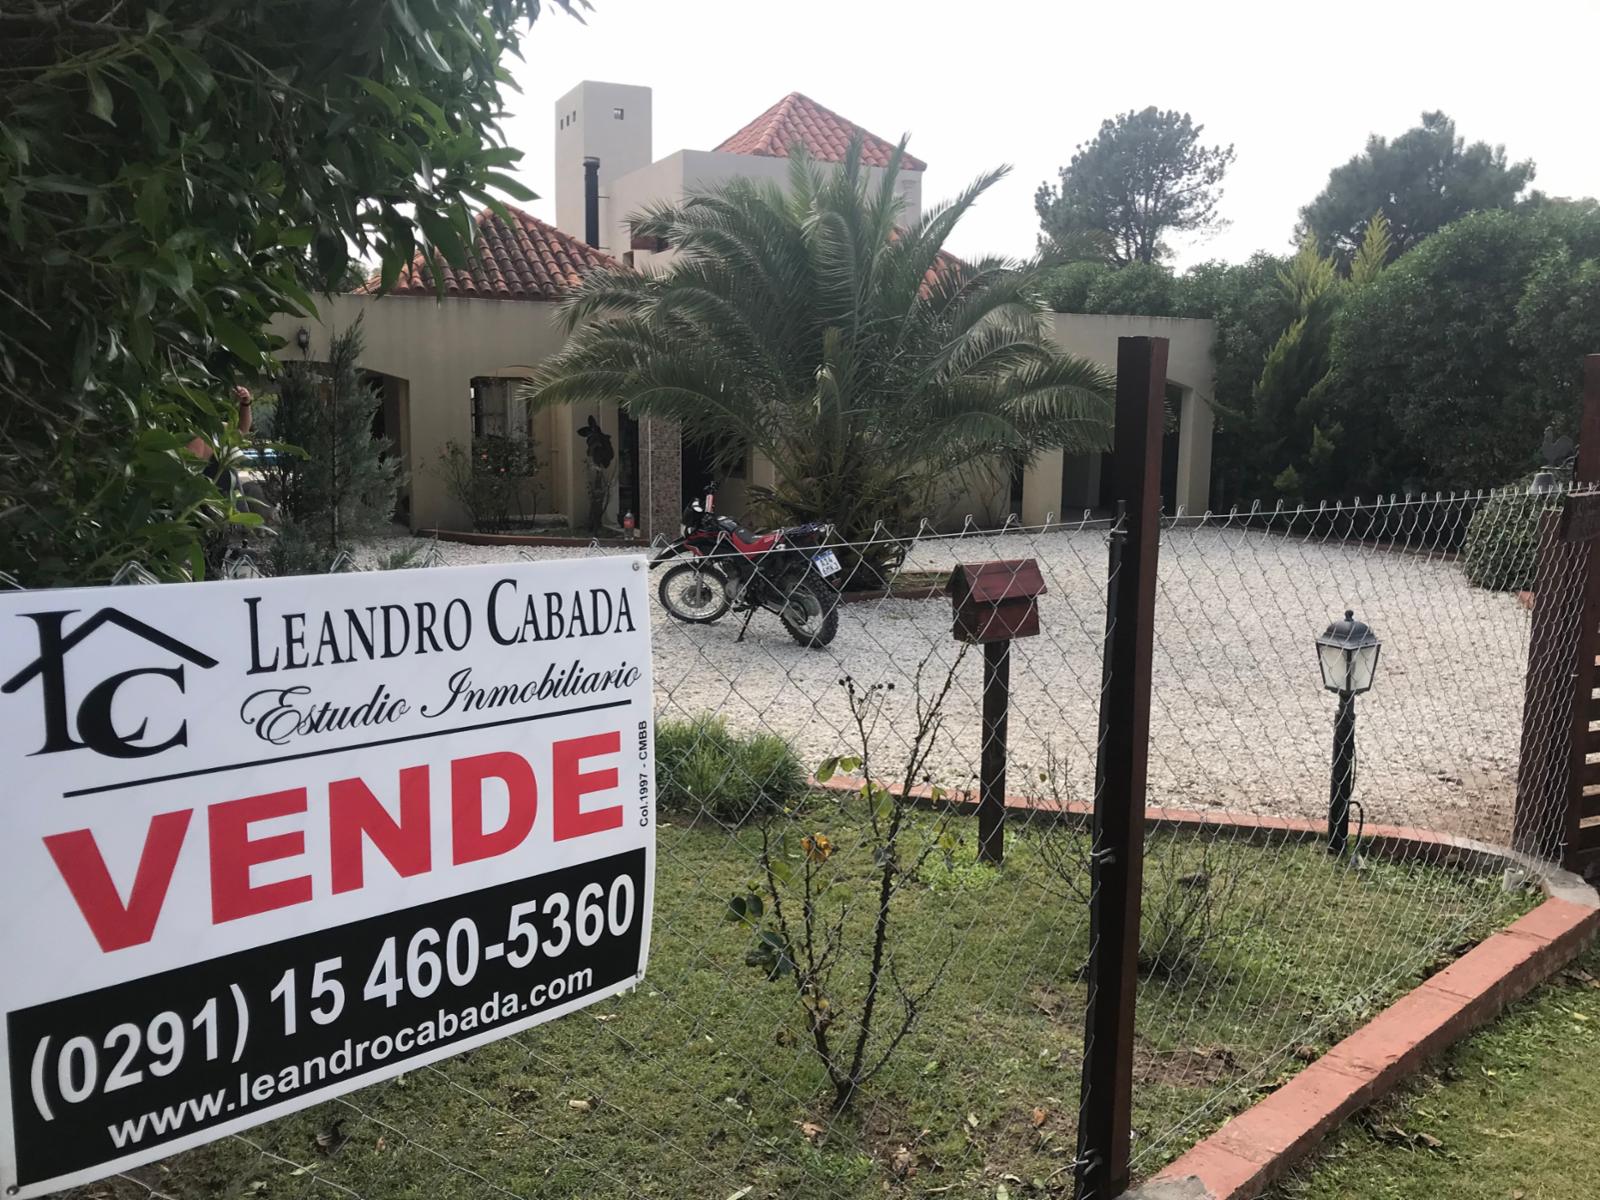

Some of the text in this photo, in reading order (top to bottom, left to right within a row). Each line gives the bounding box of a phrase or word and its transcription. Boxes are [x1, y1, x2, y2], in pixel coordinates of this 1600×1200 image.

[244, 578, 636, 676] LEANDRO CABADA
[240, 661, 642, 746] Estudio Inmobiliario
[638, 720, 648, 760] CMBB
[43, 731, 624, 954] VENDE
[639, 773, 649, 827] Col.1997
[30, 873, 636, 1122] (0291) 15 460-5360
[107, 967, 594, 1149] www.leandrocabada.com
